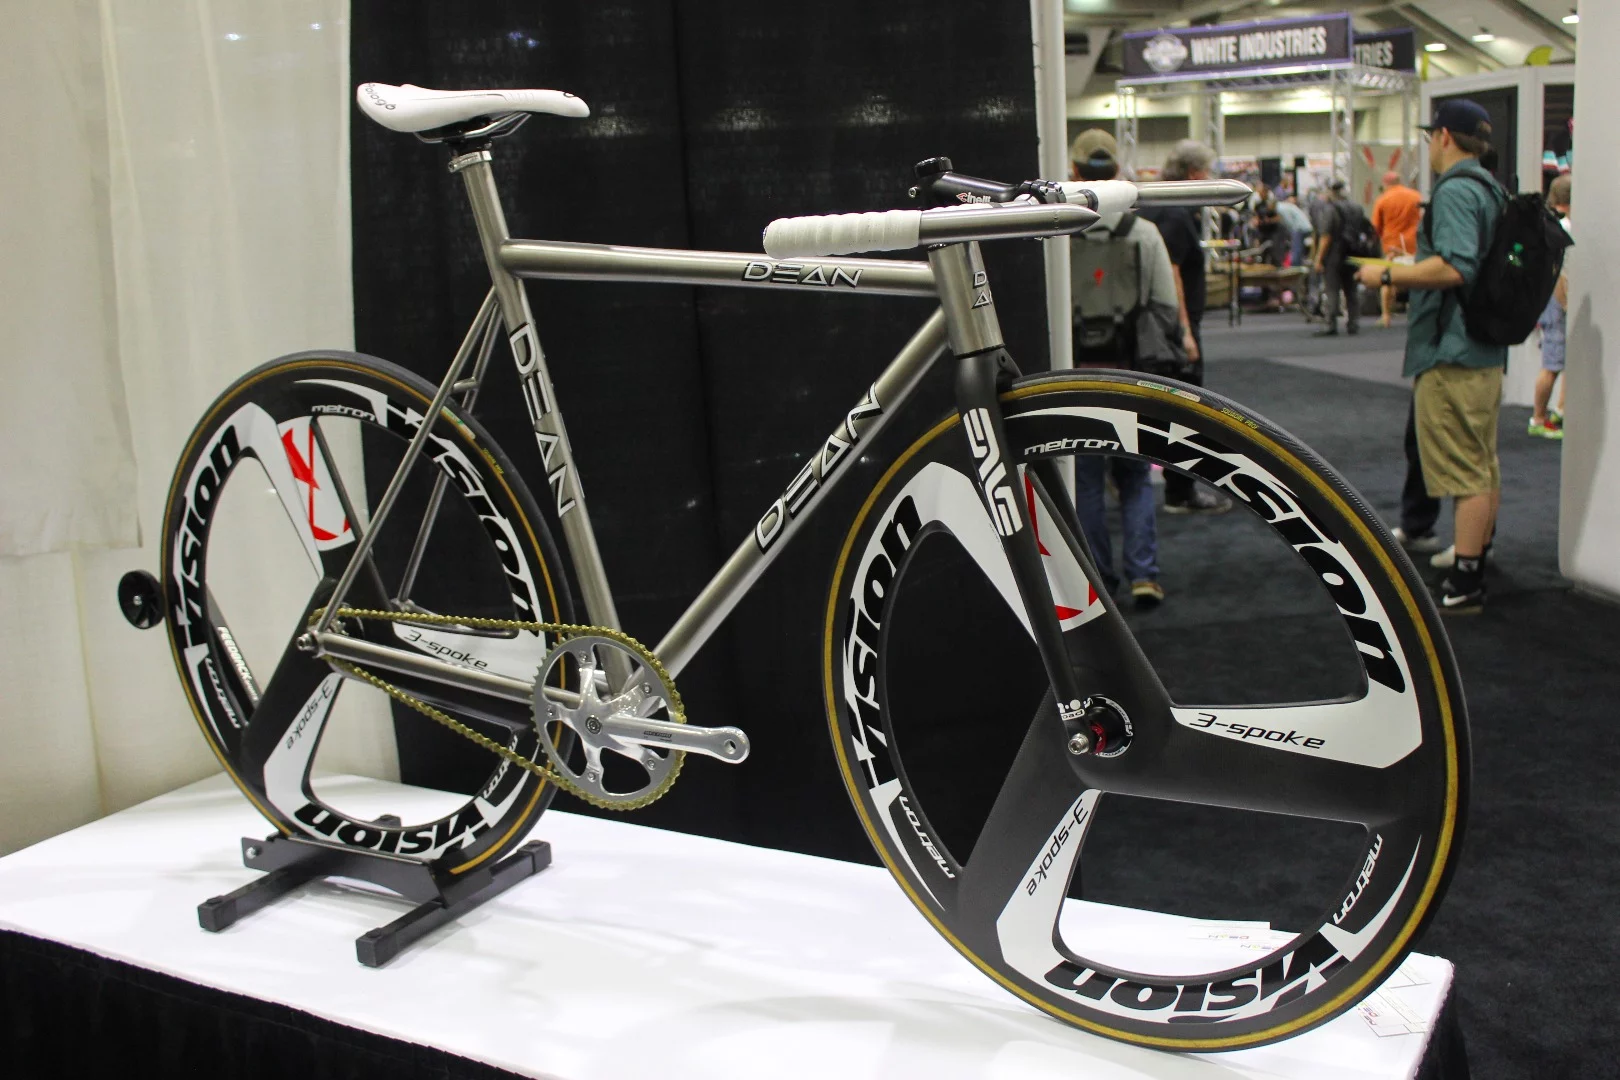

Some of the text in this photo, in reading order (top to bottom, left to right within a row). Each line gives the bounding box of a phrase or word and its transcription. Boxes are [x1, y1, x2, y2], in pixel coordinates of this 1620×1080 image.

[1190, 36, 1237, 65] WHITE
[1239, 26, 1327, 61] INDUSTRIES
[1353, 40, 1393, 67] TRIES
[742, 261, 863, 287] DEAN
[312, 404, 375, 421] metron
[509, 322, 576, 518] DEAN
[1024, 437, 1120, 456] metron
[755, 381, 884, 555] DEAN
[403, 629, 488, 670] 3-spoke
[286, 680, 333, 750] 3-spoke
[1189, 712, 1326, 750] 3-spoke
[899, 795, 955, 881] metron
[1025, 798, 1089, 897] 3-spoke
[1333, 834, 1384, 925] metron
